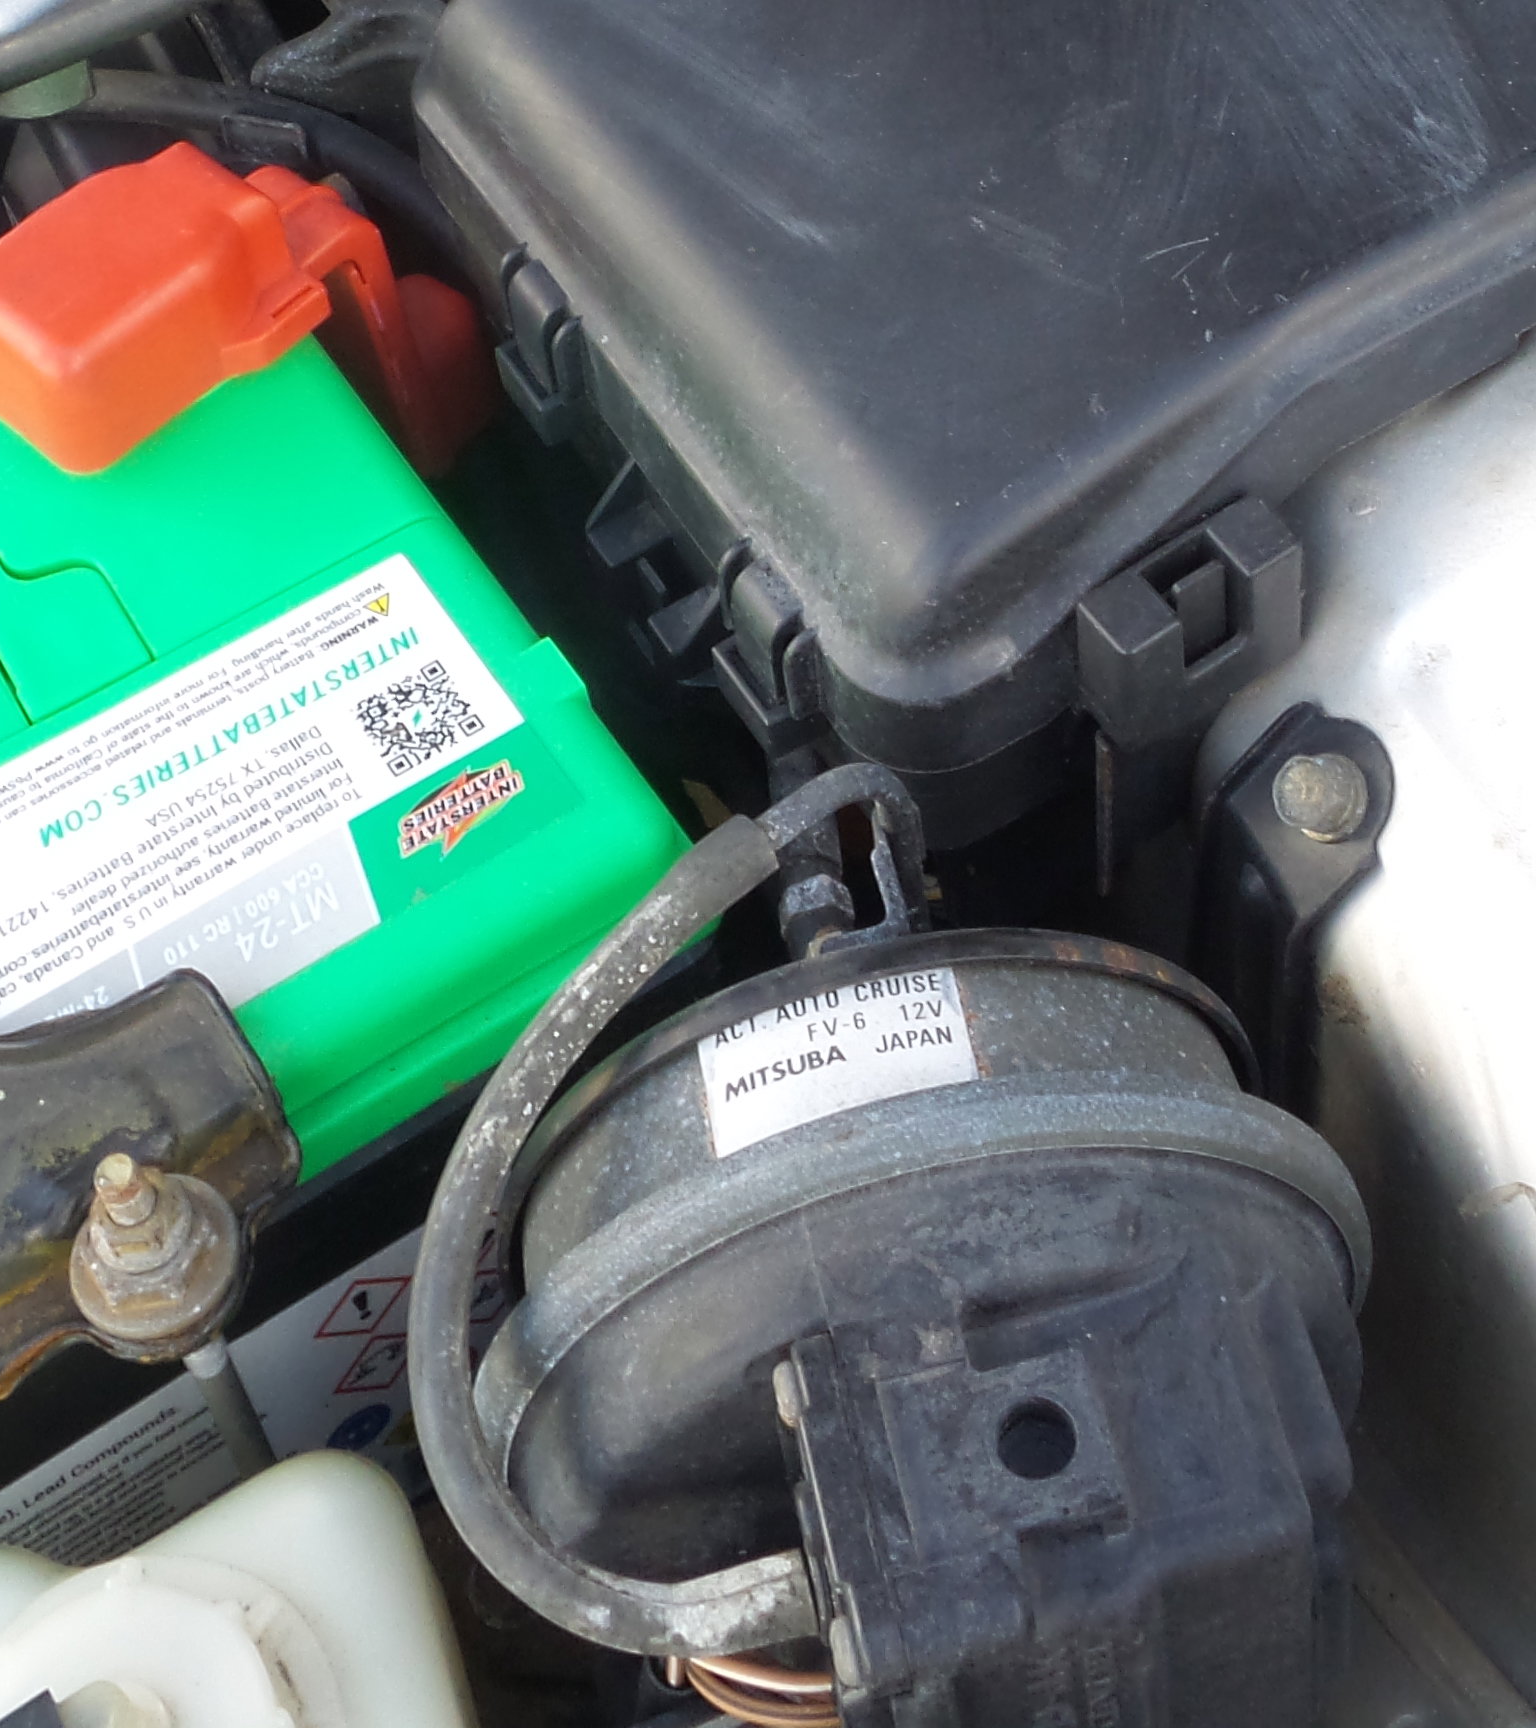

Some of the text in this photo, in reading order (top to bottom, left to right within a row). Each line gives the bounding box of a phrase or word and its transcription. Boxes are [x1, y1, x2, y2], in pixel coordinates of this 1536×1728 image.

[273, 650, 315, 674] Battery
[101, 698, 170, 737] information
[175, 695, 232, 727] terminals
[40, 627, 419, 847] INTERSTATEBATTERIES.COM
[30, 764, 101, 805] accessories
[44, 749, 103, 783] California
[145, 726, 322, 827] Dallas, TX 75254 USA
[243, 742, 333, 798] Distributed
[328, 773, 352, 791] For
[274, 788, 327, 823] limited
[287, 797, 339, 833] replace
[342, 789, 362, 801] To
[397, 776, 522, 851] INTERSTATE
[398, 765, 509, 833] BATTERIES
[72, 758, 344, 915] Interstate Batteries authorized dealer
[138, 805, 218, 854] Interstate
[242, 831, 282, 859] under
[52, 852, 133, 900] Batteries,
[171, 857, 237, 898] warranty
[176, 856, 200, 876] see
[163, 862, 324, 966] CCA 600 RC 110
[235, 881, 340, 963] MT-24
[86, 926, 114, 951] and
[19, 946, 83, 983] Canada,
[776, 989, 840, 1024] AUTO
[854, 973, 941, 1002] CRUISE
[899, 1000, 943, 1022] 12V
[725, 1026, 953, 1102] MITSUBA JAPAN
[22, 1475, 66, 1509] Lead
[71, 1406, 181, 1477] Compounds
